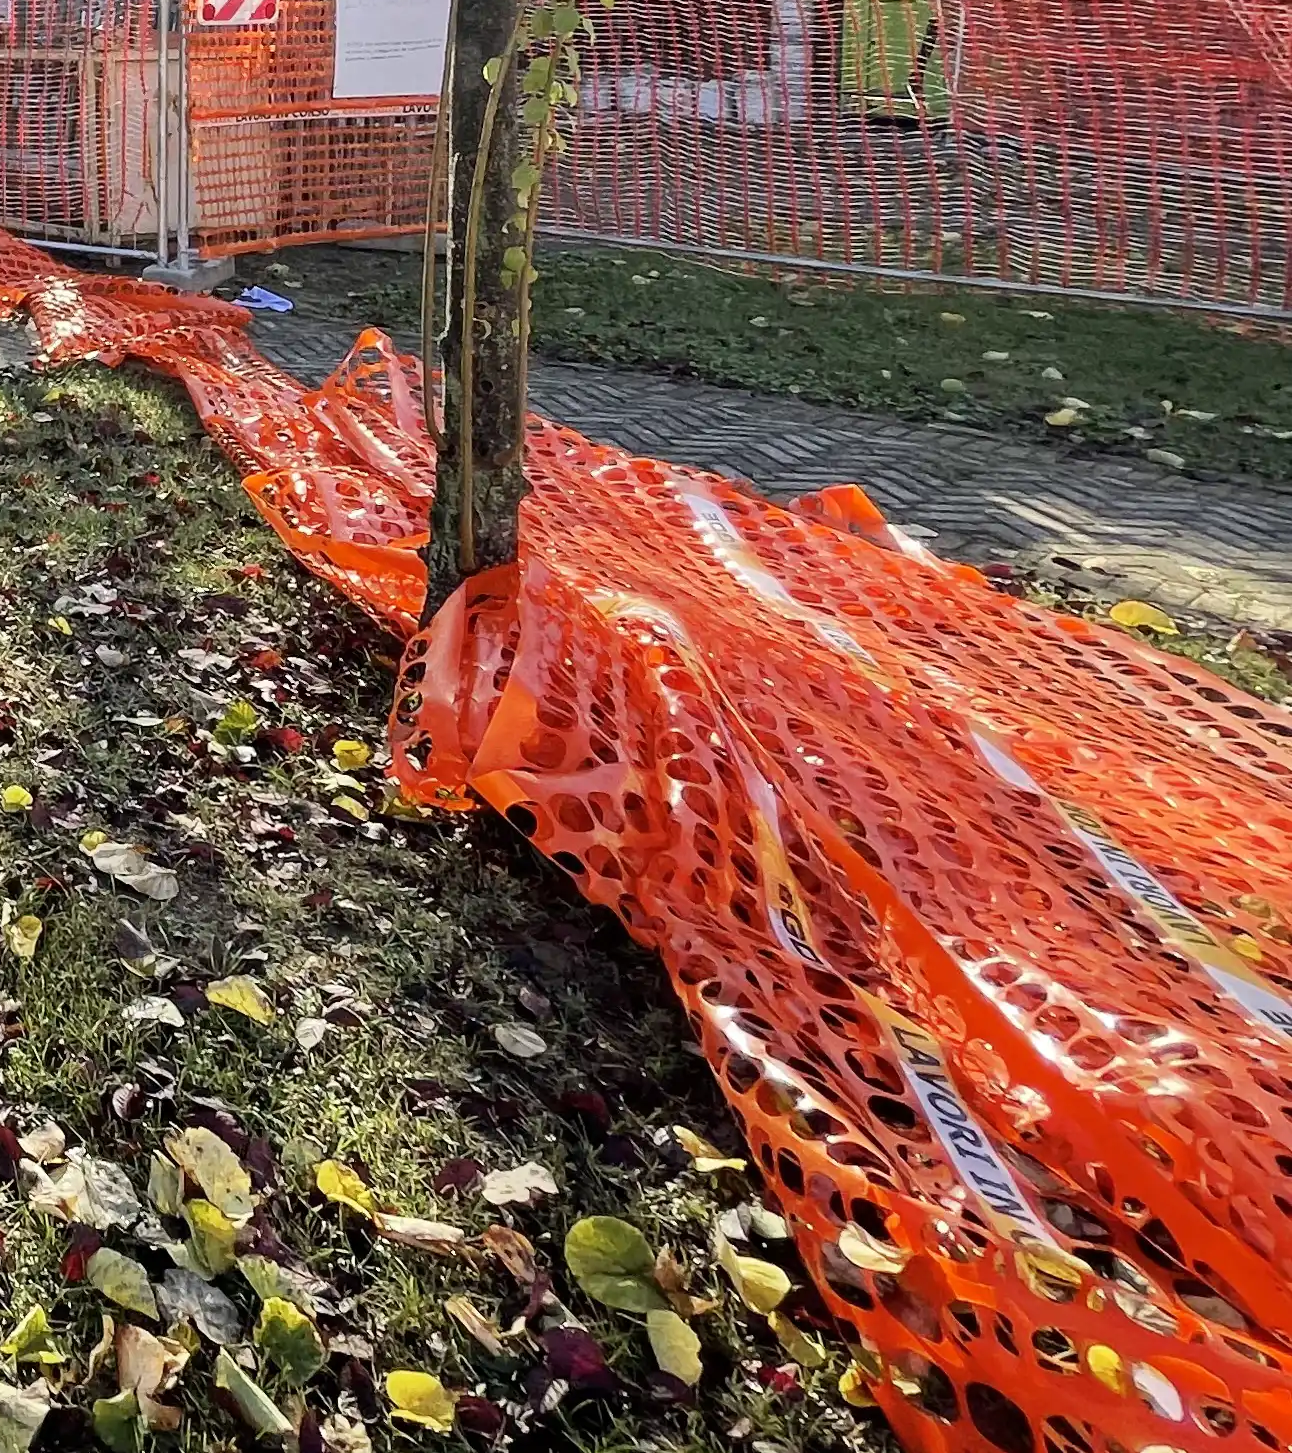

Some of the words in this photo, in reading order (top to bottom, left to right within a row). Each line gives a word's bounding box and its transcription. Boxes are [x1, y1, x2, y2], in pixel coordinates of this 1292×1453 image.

[1092, 840, 1141, 870] IN
[1117, 868, 1221, 948] LAVORI
[891, 1024, 1000, 1171] LAVORI
[969, 1170, 1036, 1225] IN
